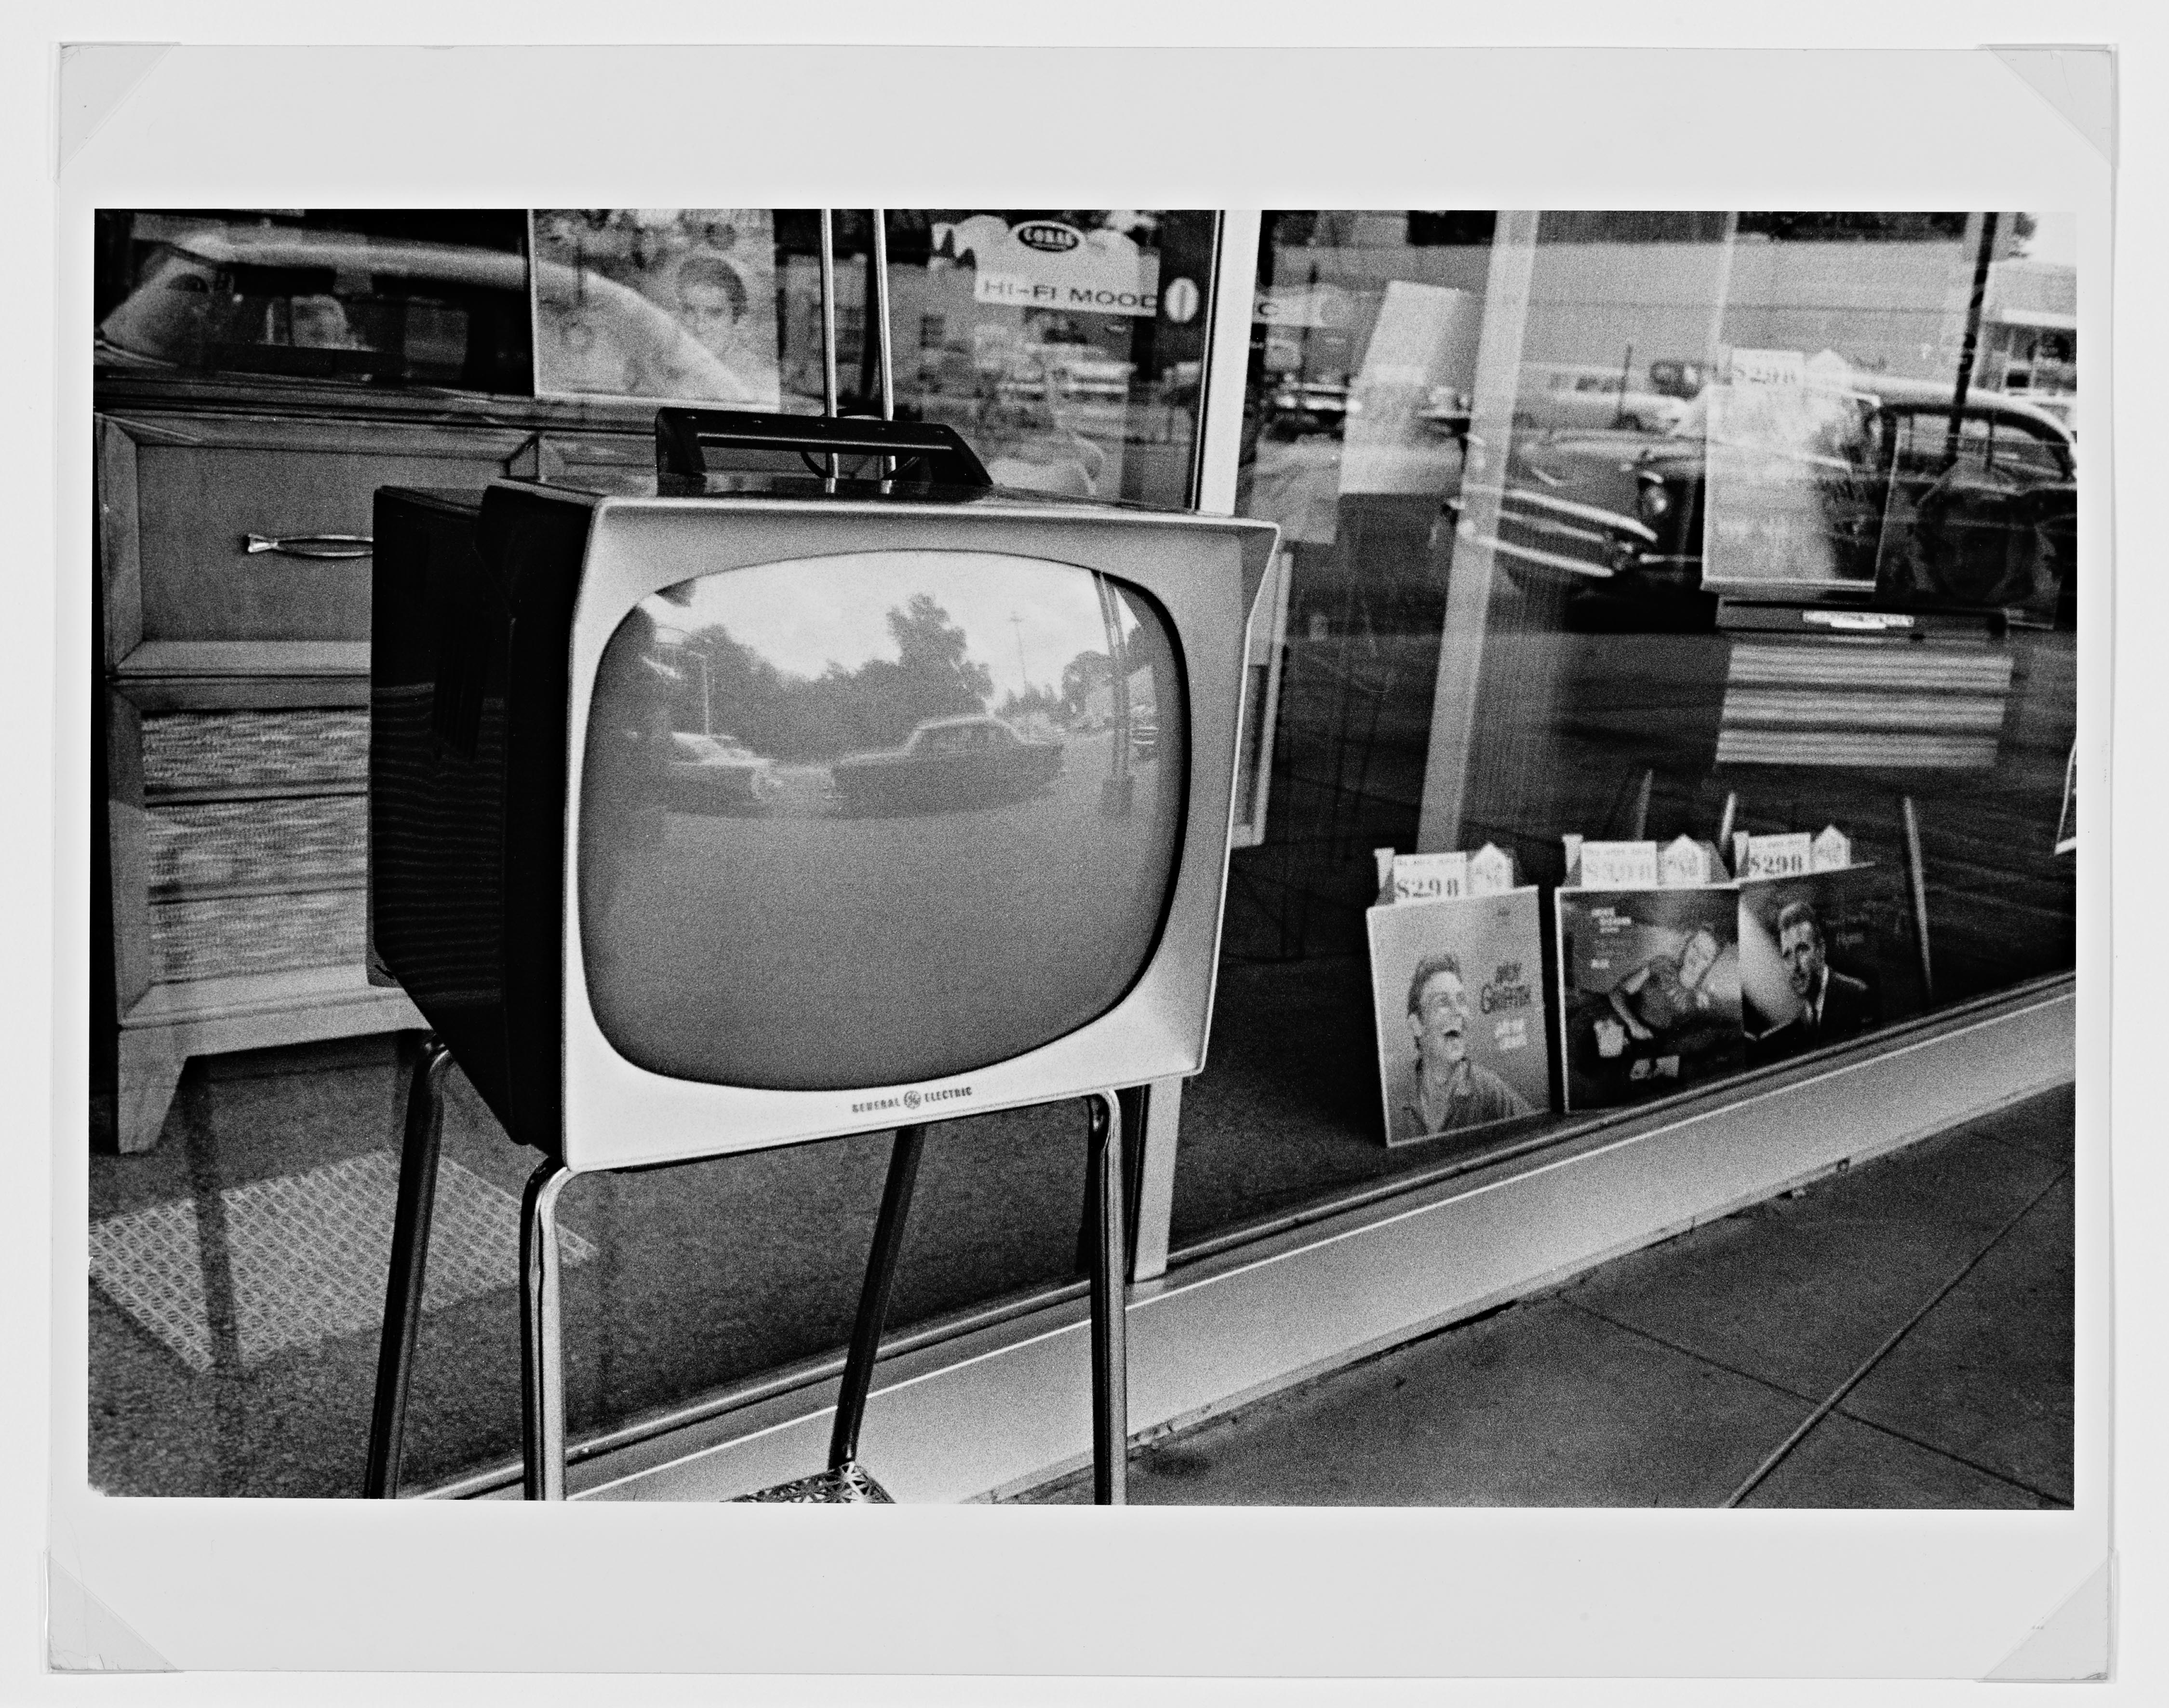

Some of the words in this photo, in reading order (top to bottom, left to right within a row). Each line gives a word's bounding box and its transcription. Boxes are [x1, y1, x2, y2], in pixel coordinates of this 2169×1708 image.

[984, 280, 1056, 300] HI-FI
[852, 1098, 900, 1113] GENERAL
[924, 1087, 972, 1102] ELECTRIC
